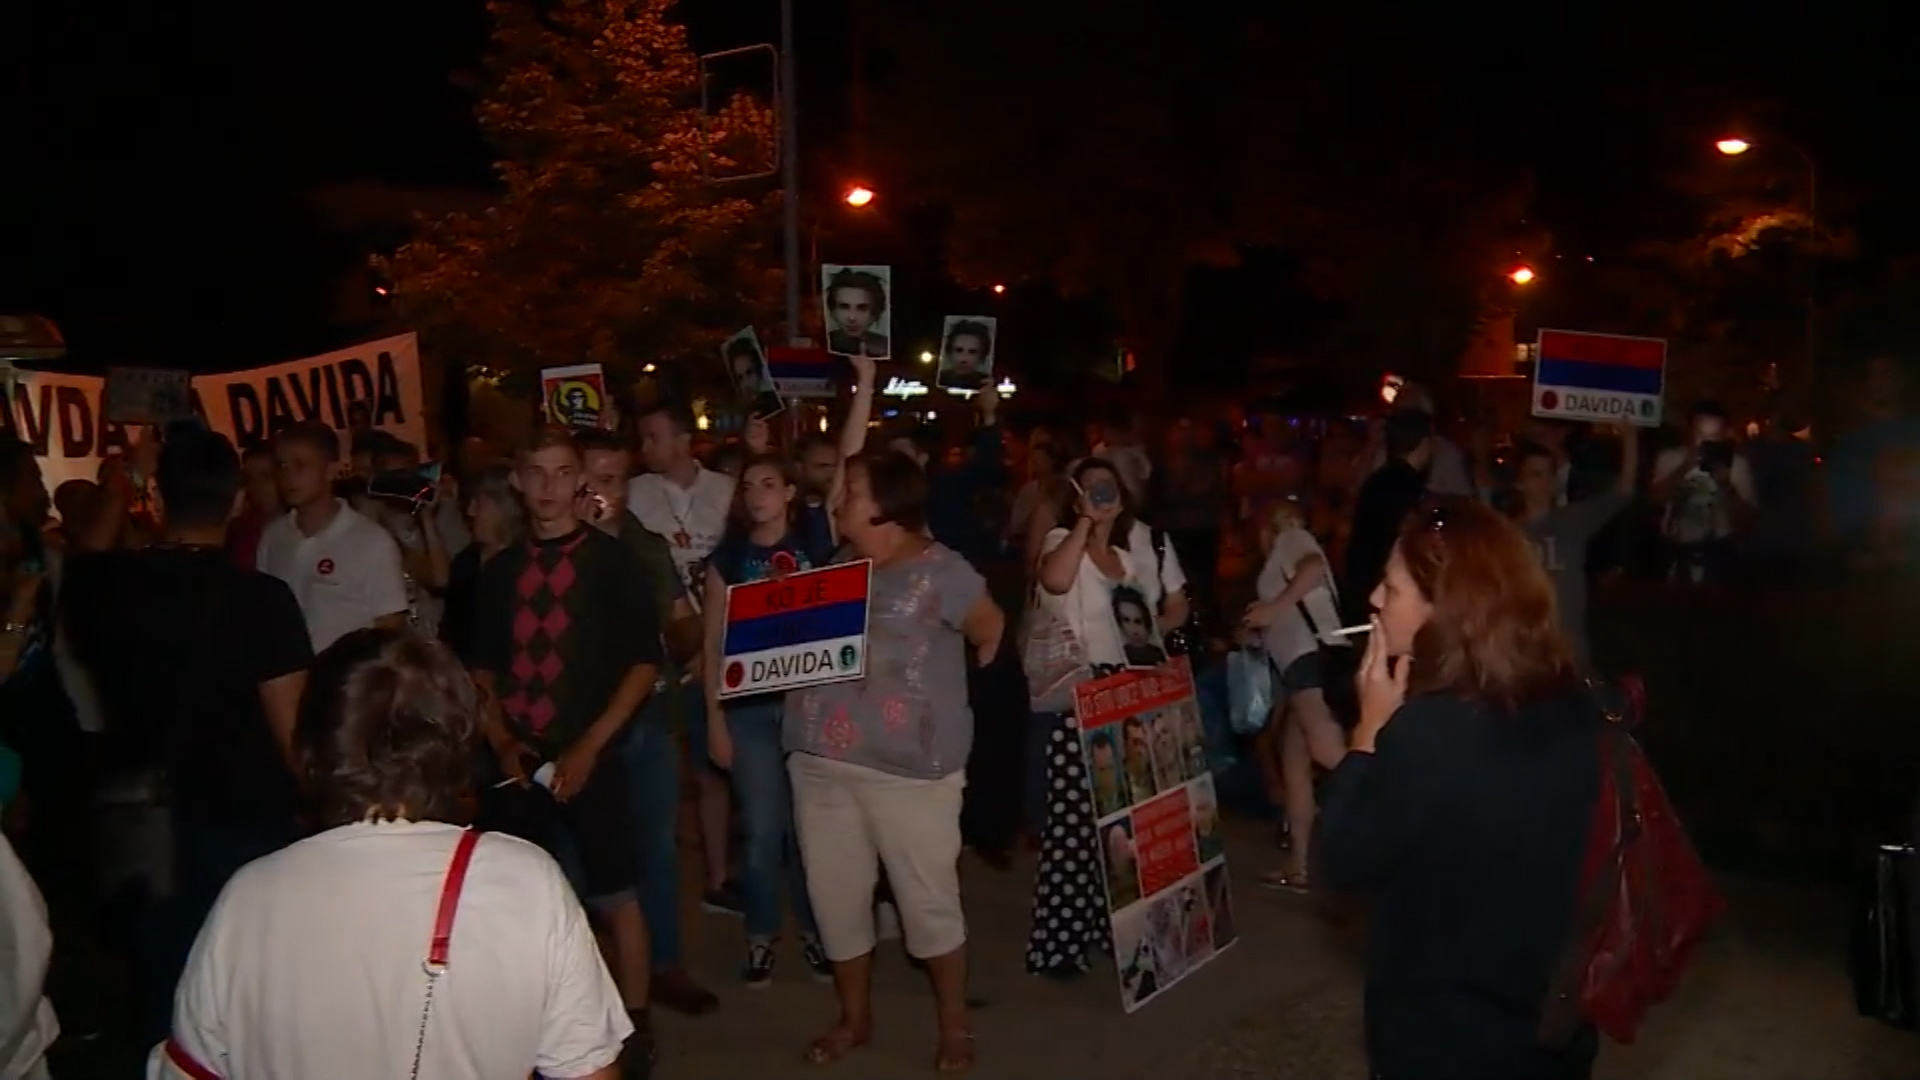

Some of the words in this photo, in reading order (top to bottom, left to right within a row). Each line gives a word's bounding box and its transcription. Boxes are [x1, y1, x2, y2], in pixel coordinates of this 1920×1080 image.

[228, 352, 404, 447] DAVIDA
[1565, 393, 1636, 416] DAVIDA
[752, 649, 834, 683] DAVIDA
